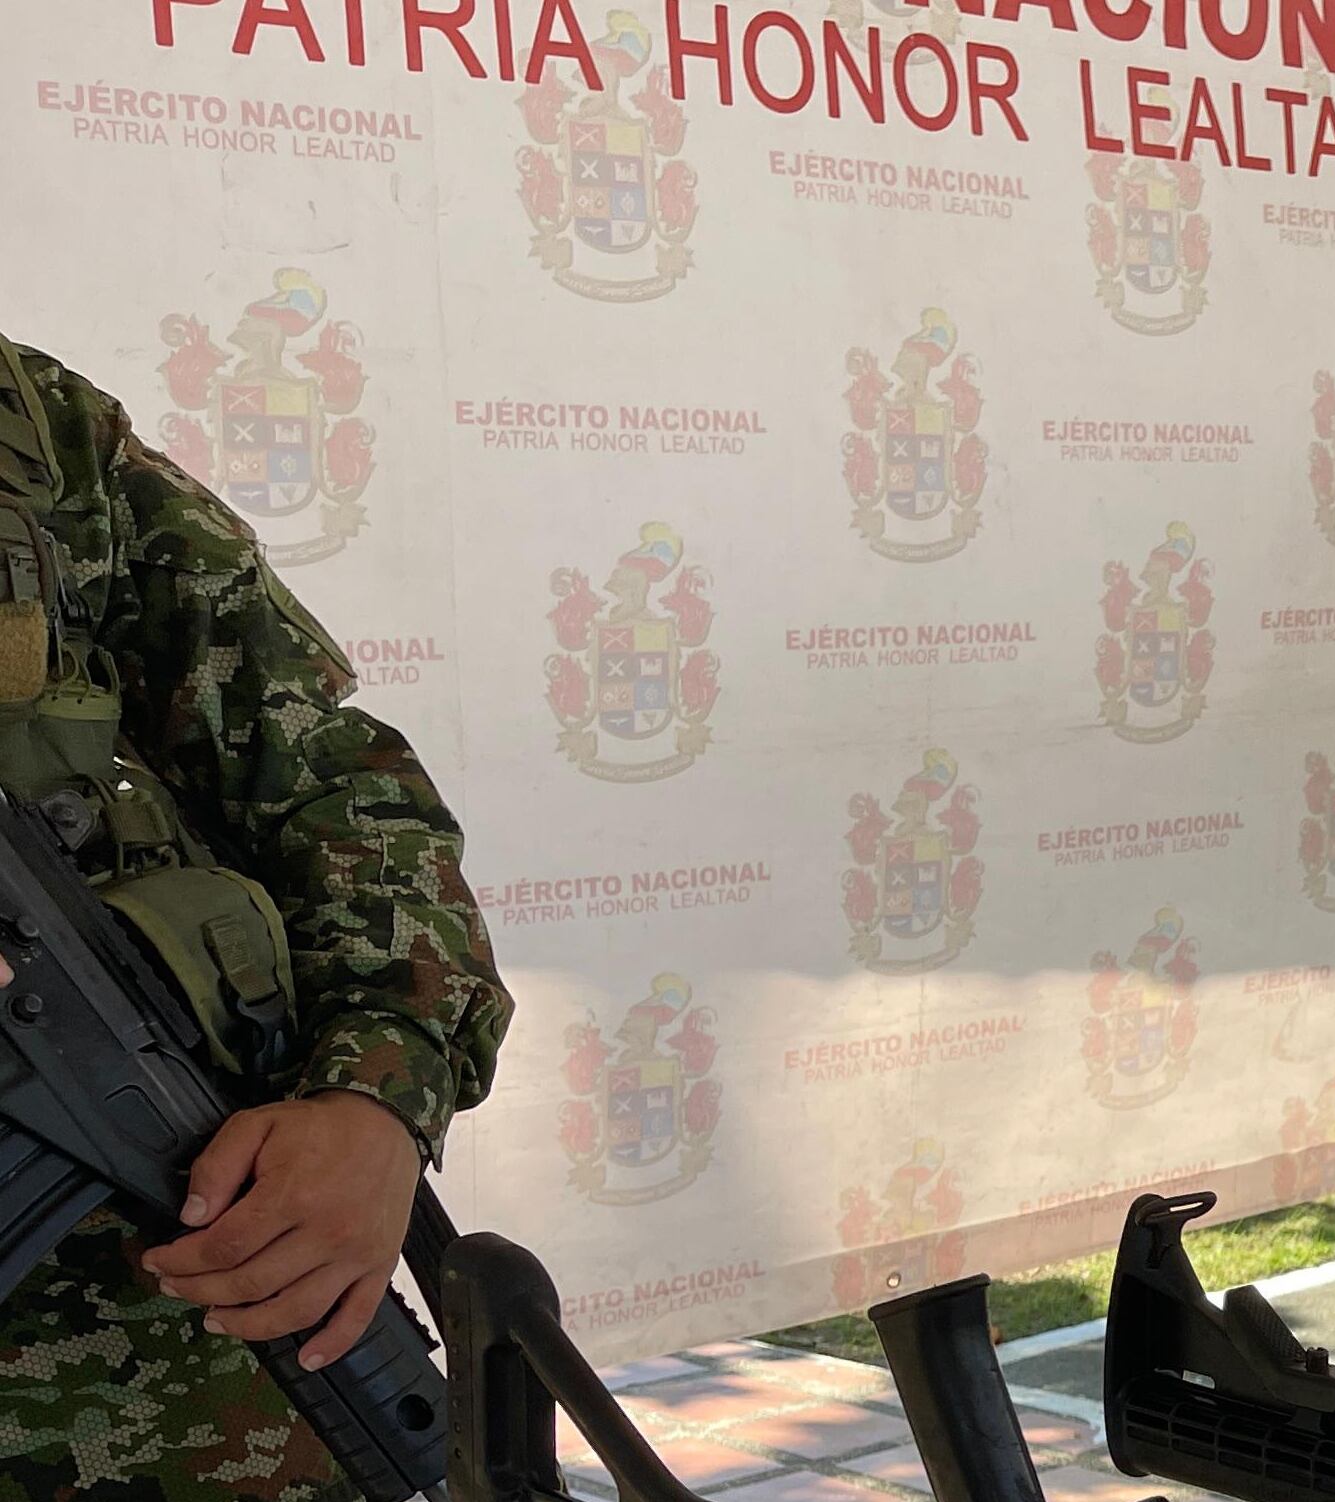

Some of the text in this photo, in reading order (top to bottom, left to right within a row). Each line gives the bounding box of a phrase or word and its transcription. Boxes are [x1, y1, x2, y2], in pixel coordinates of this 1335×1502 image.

[665, 0, 1029, 141] HONOR
[37, 79, 423, 141] EJÉRCITO NACIONAL
[73, 118, 396, 163] PATRIA HONOR LEALTAD
[769, 149, 1031, 201] EJÉRCITO NACIONAL
[793, 181, 1013, 221] PATRIA HONOR LEALTAD
[455, 396, 768, 434] EJÉRCITO NACIONAL
[1042, 416, 1254, 445] EJÉRCITO NACIONAL
[483, 430, 745, 455] PATRIA HONOR LEALTAD
[1061, 445, 1113, 461] PATRIA
[1181, 446, 1240, 463] LEALTAD
[345, 638, 445, 663] IONAL
[786, 621, 1037, 650] EJÉRCITO NACIONAL
[807, 645, 1019, 670] PATRIA HONOR LEALTAD
[1038, 811, 1244, 851] EJÉRCITO NACIONAL
[1055, 832, 1230, 866] PATRIA HONOR LEALTAD
[477, 862, 771, 908] EJÉRCITO NACIONAL
[503, 886, 750, 927] PATRIA HONOR LEALTAD
[784, 1015, 1025, 1069] EJÉRCITO NACIONAL
[804, 1038, 1006, 1085] PATRIA HONOR LEALTAD
[634, 1261, 766, 1303] NACIONAL
[590, 1301, 658, 1330] HONOR
[669, 1284, 746, 1312] LEALTAD
